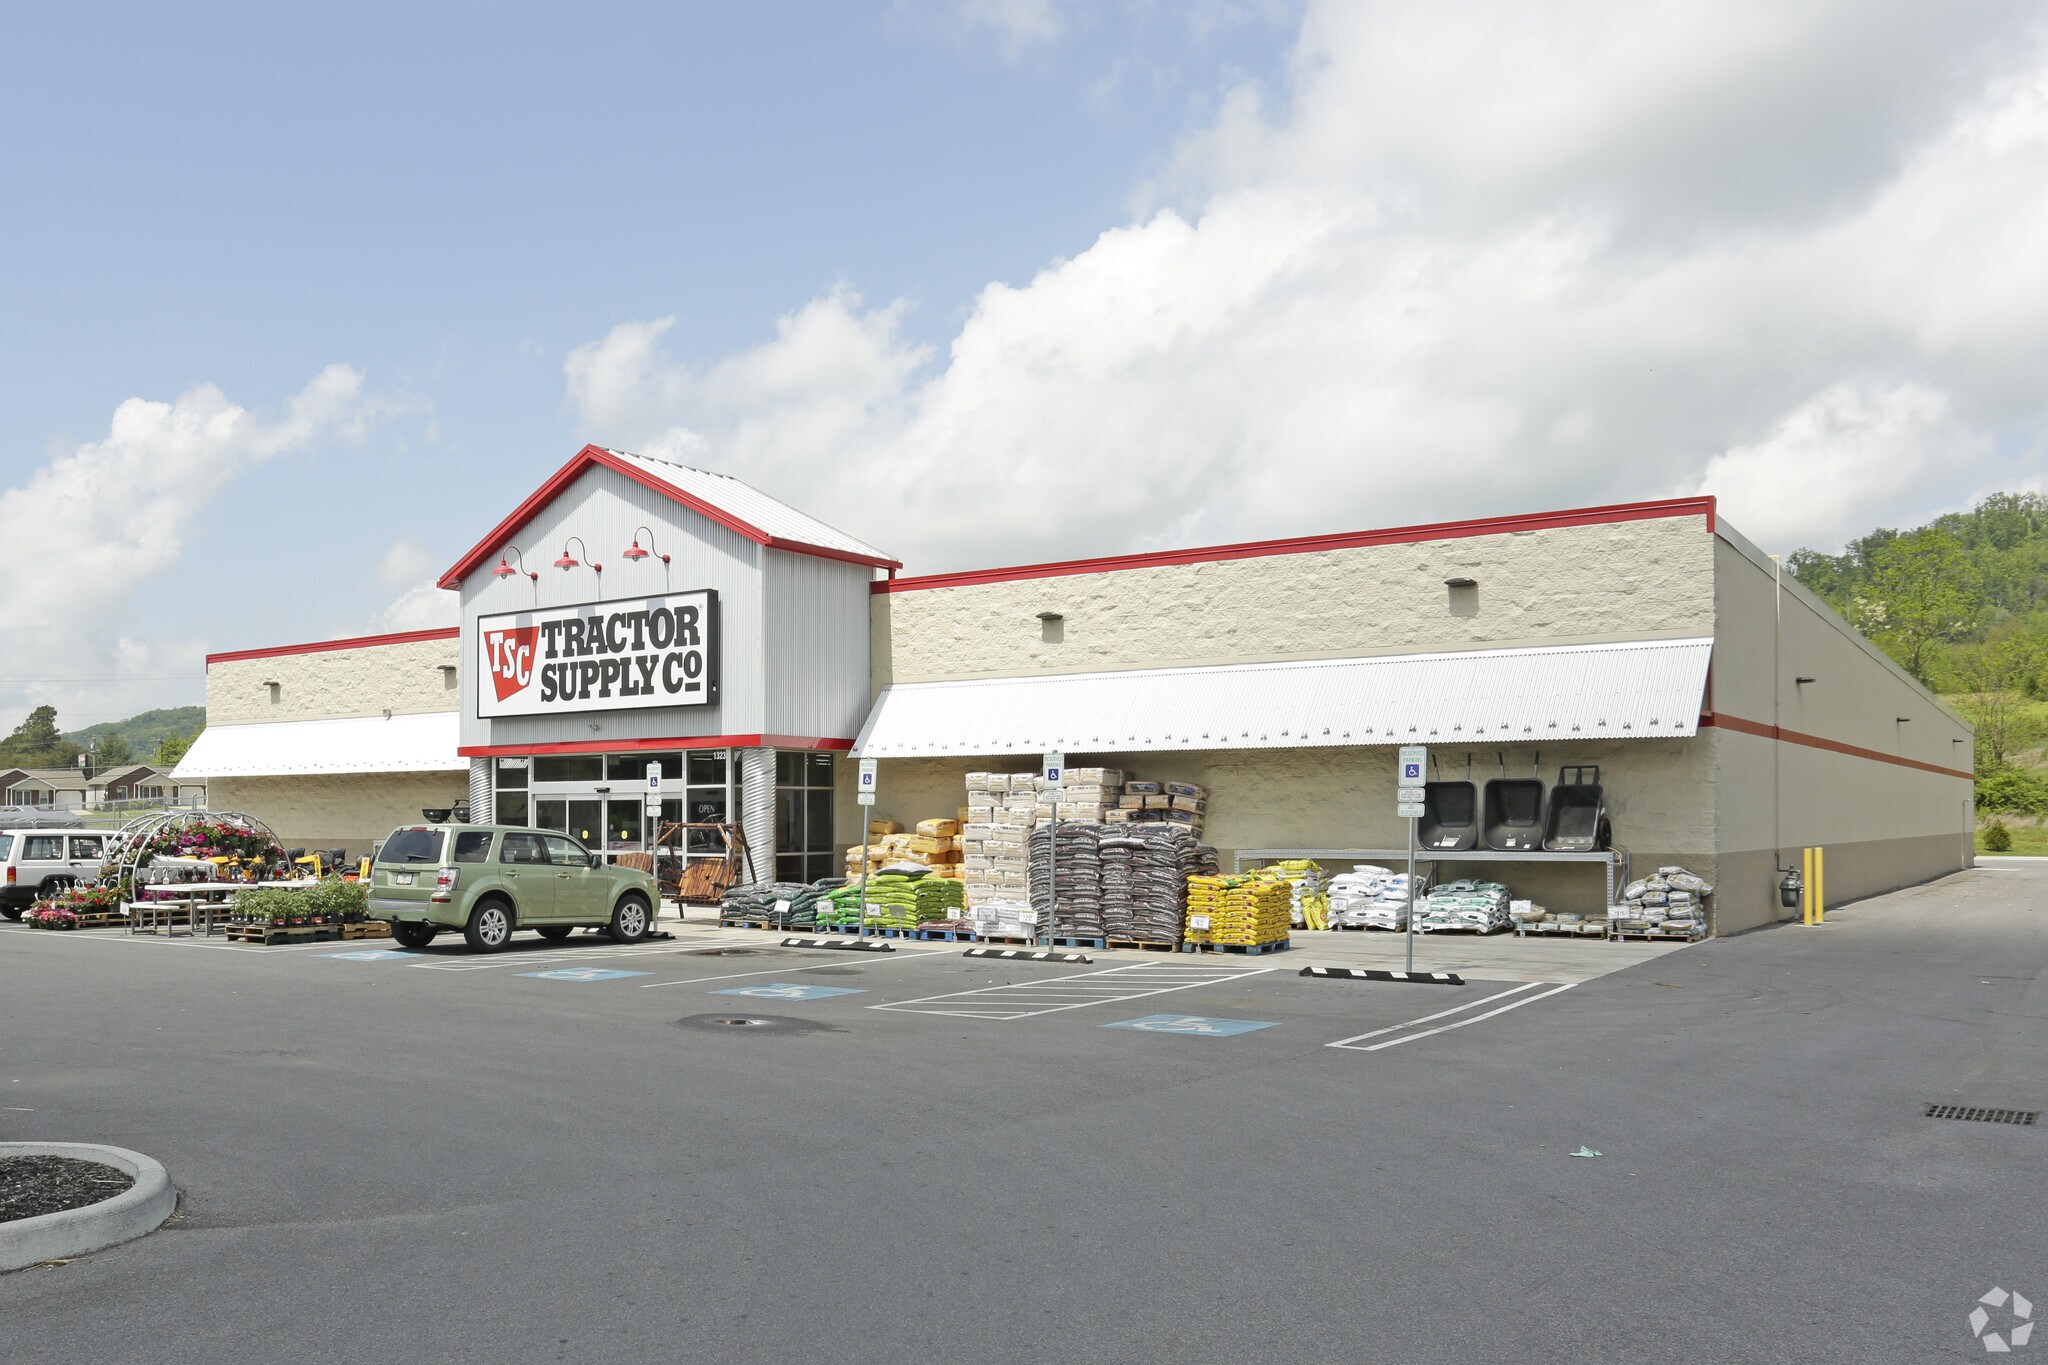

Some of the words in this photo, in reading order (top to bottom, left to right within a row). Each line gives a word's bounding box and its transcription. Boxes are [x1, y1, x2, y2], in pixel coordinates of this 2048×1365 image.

[541, 605, 700, 660] TRACTOR
[490, 631, 530, 686] TSC
[541, 654, 659, 702] SUPPLY
[713, 751, 726, 760] 1323
[698, 804, 715, 814] OPEN
